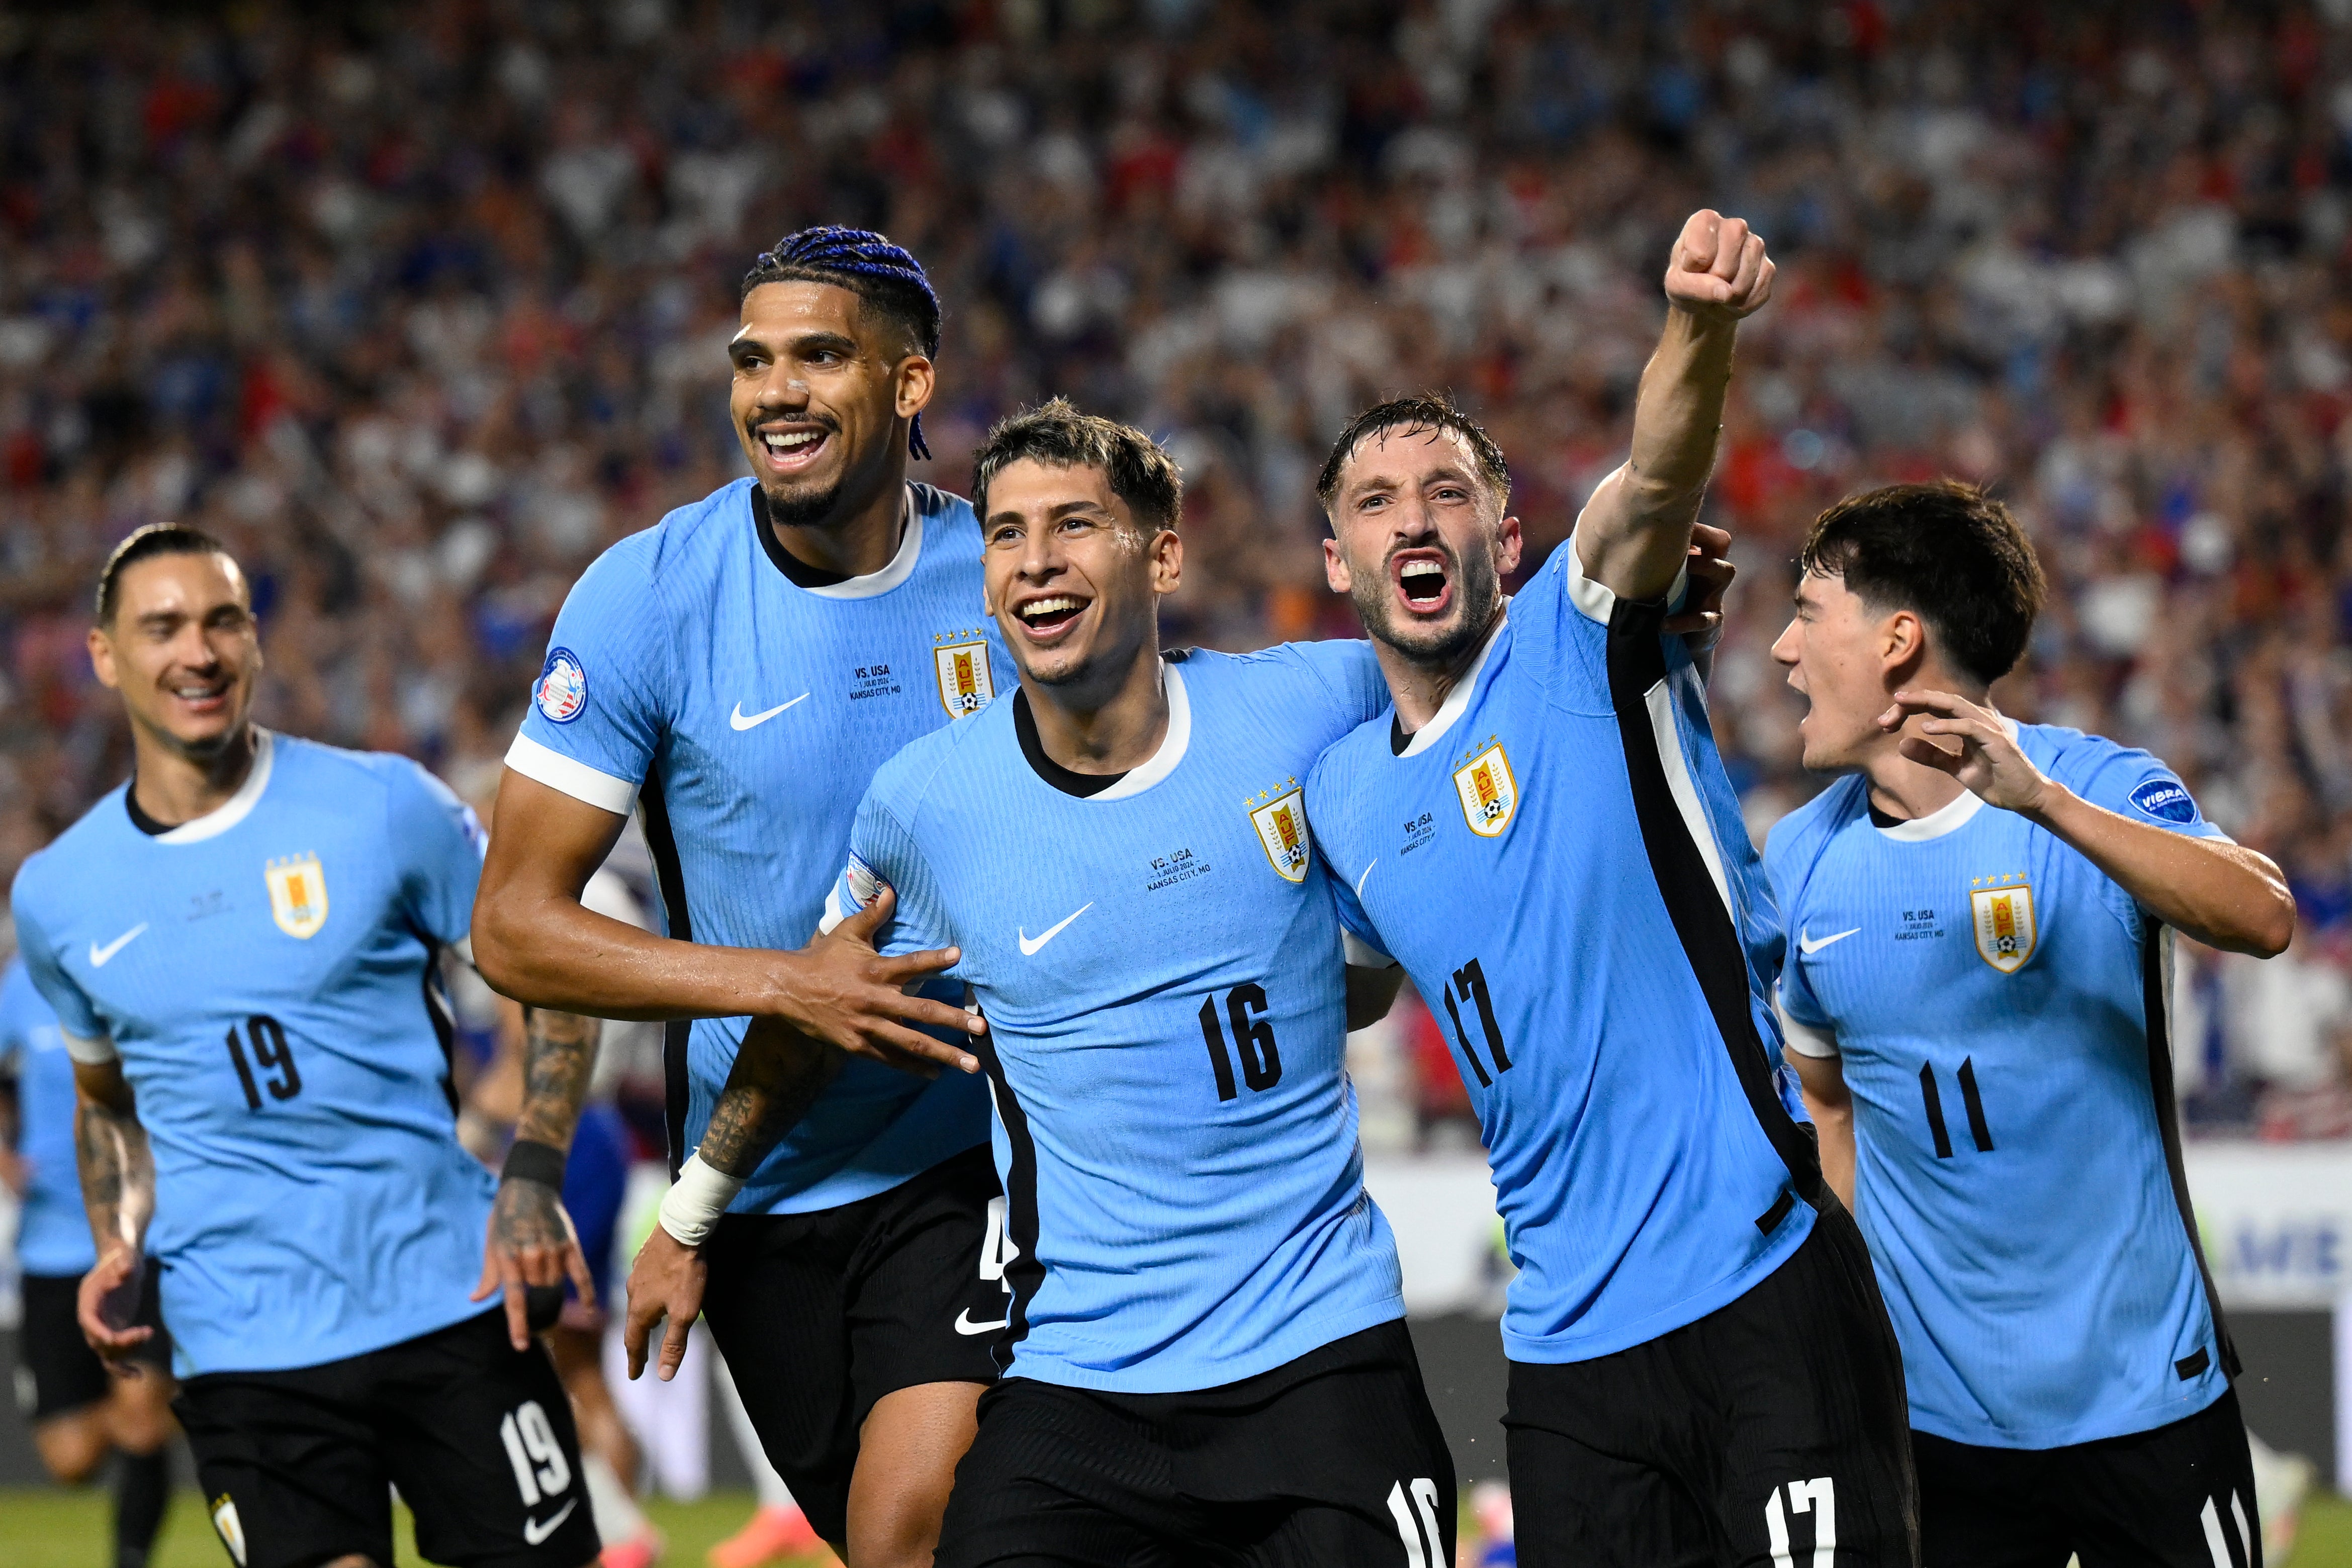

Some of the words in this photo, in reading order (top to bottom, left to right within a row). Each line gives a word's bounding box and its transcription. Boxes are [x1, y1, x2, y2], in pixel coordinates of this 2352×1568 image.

[855, 667, 870, 679] VS.
[871, 664, 890, 676] USA
[863, 679, 876, 687] JULIO
[877, 677, 889, 685] 2024
[958, 659, 972, 690] AUF
[850, 689, 875, 700] KANSAS
[875, 687, 890, 696] CITY,
[891, 685, 900, 694] MO
[1478, 771, 1494, 801] AUF
[2142, 788, 2185, 808] VIBRA
[1279, 813, 1295, 845] AUF
[1404, 821, 1417, 834] VS.
[1418, 812, 1433, 826] USA
[1150, 858, 1169, 870] VS.
[1169, 848, 1193, 863] USA
[1401, 840, 1419, 857] KANSAS
[1147, 875, 1178, 892] KANSAS
[1179, 869, 1198, 881] CITY,
[1198, 864, 1211, 875] MO
[1162, 865, 1179, 877] JULIO
[1180, 860, 1194, 870] 2024
[1903, 911, 1916, 921] VS.
[1918, 909, 1935, 920] USA
[1996, 902, 2011, 934] AUF
[1894, 932, 1919, 941] KANSAS
[1444, 957, 1512, 1088] 17
[1198, 982, 1283, 1102] 16
[226, 1014, 302, 1109] 19
[1919, 1054, 1994, 1158] 11
[980, 1195, 1020, 1293] 4
[500, 1400, 572, 1507] 19
[1765, 1477, 1836, 1568] 17
[2200, 1487, 2252, 1568] 11
